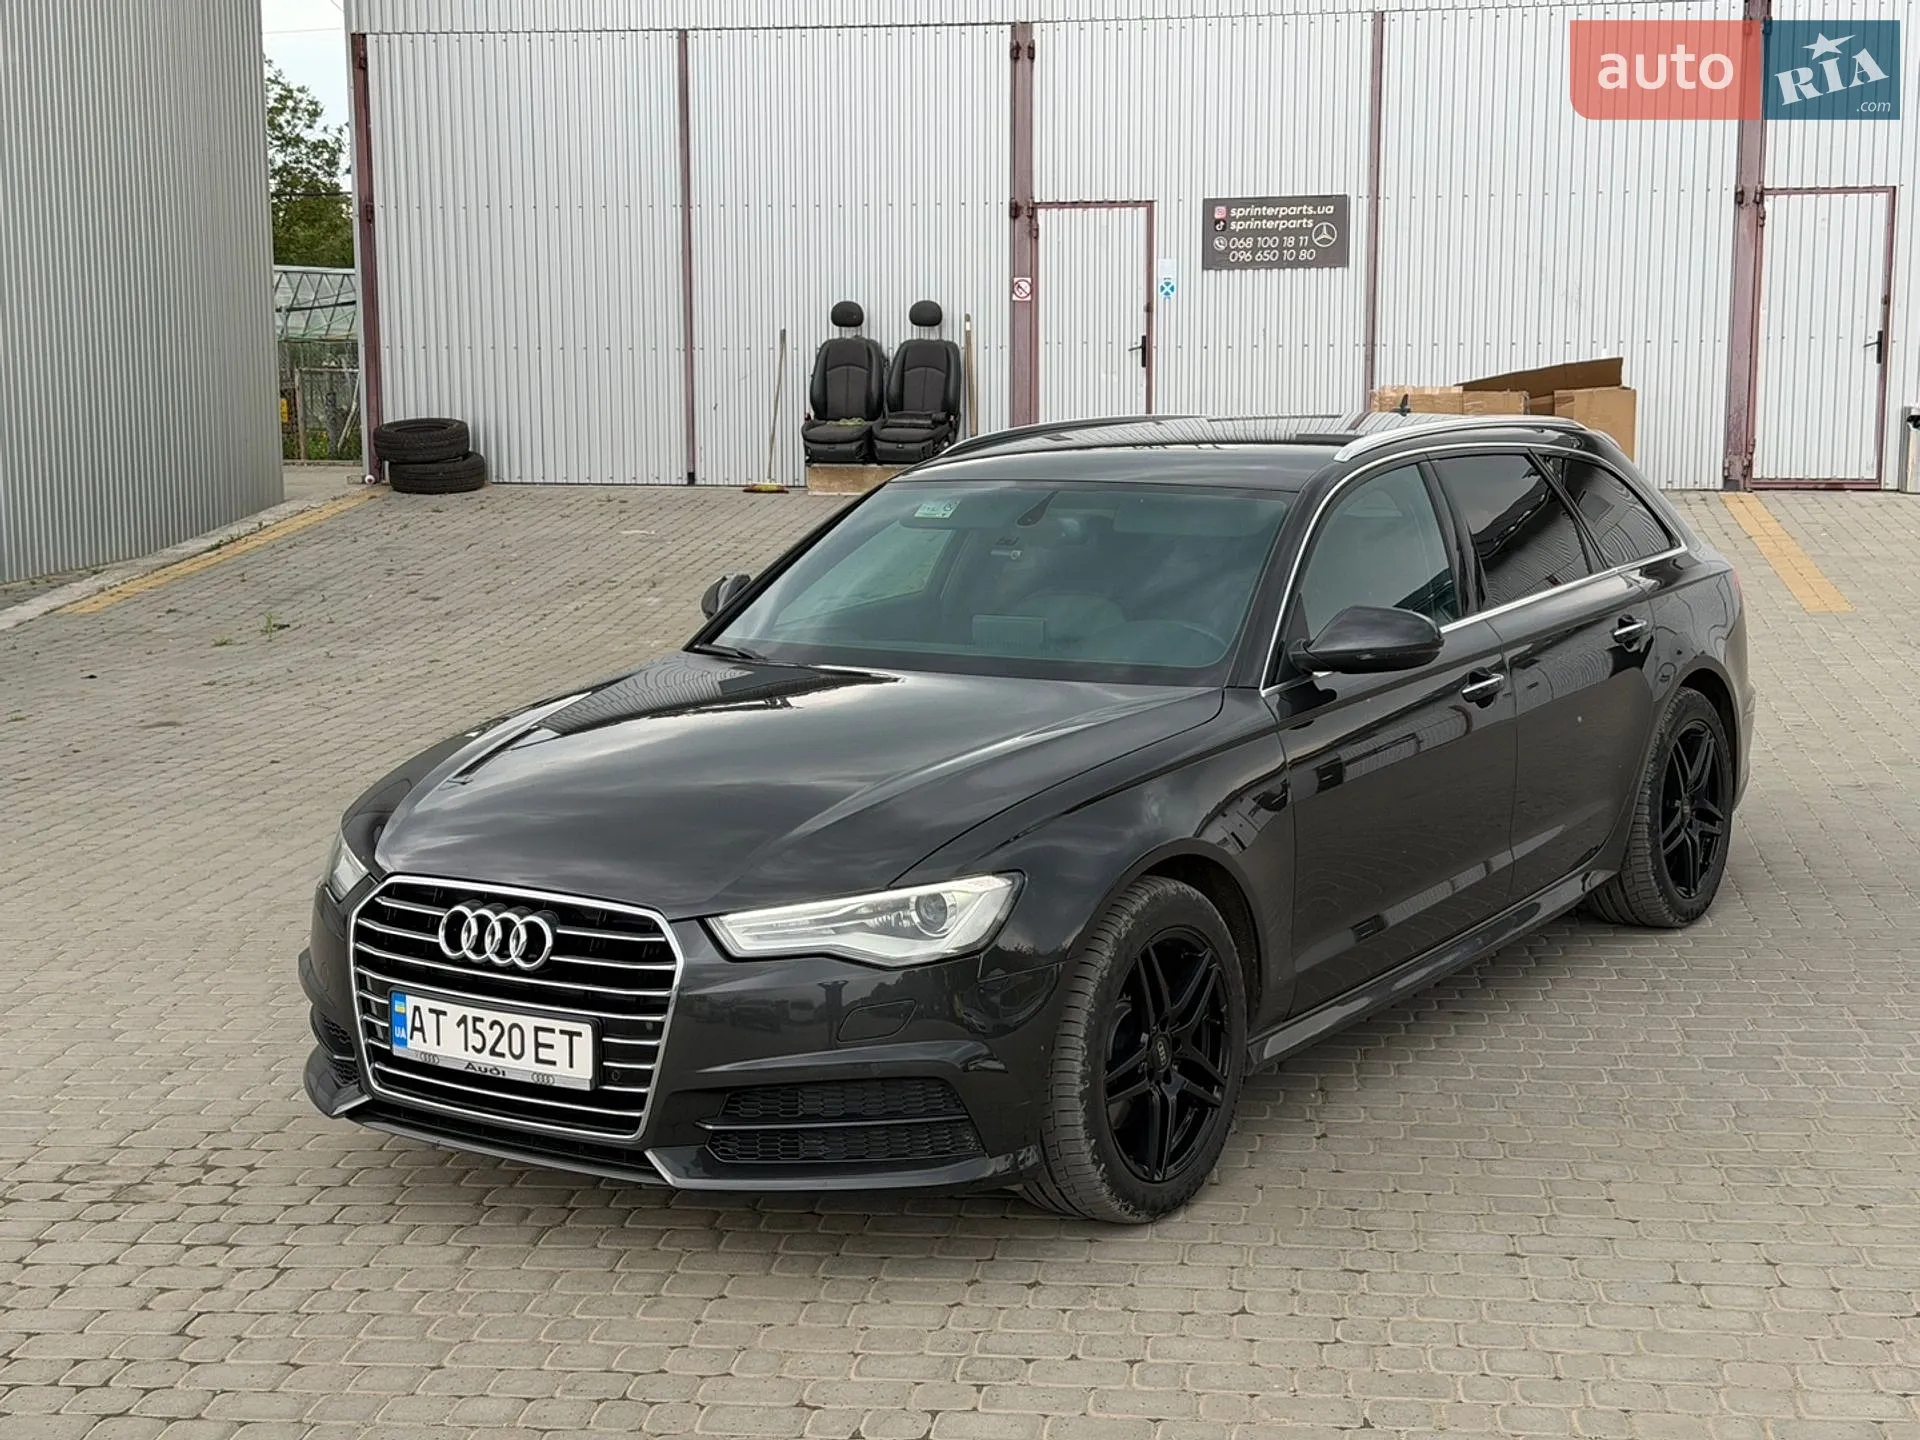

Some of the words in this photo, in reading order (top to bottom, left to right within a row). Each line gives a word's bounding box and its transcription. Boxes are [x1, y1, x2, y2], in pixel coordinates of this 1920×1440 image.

[1230, 205, 1334, 218] sprinterparts.ua
[1229, 218, 1314, 232] sprinterparts
[1229, 237, 1253, 249] 068
[1257, 236, 1279, 248] 100
[1283, 236, 1295, 248] 18
[1299, 236, 1309, 247] 11
[1229, 251, 1252, 262] 096
[1255, 250, 1279, 262] 650
[1283, 249, 1296, 261] 10
[1299, 249, 1316, 260] 80
[394, 1026, 407, 1039] UA
[409, 1005, 448, 1047] AT
[456, 1014, 525, 1061] 1520
[533, 1026, 583, 1069] ET
[464, 1062, 506, 1077] Audi
